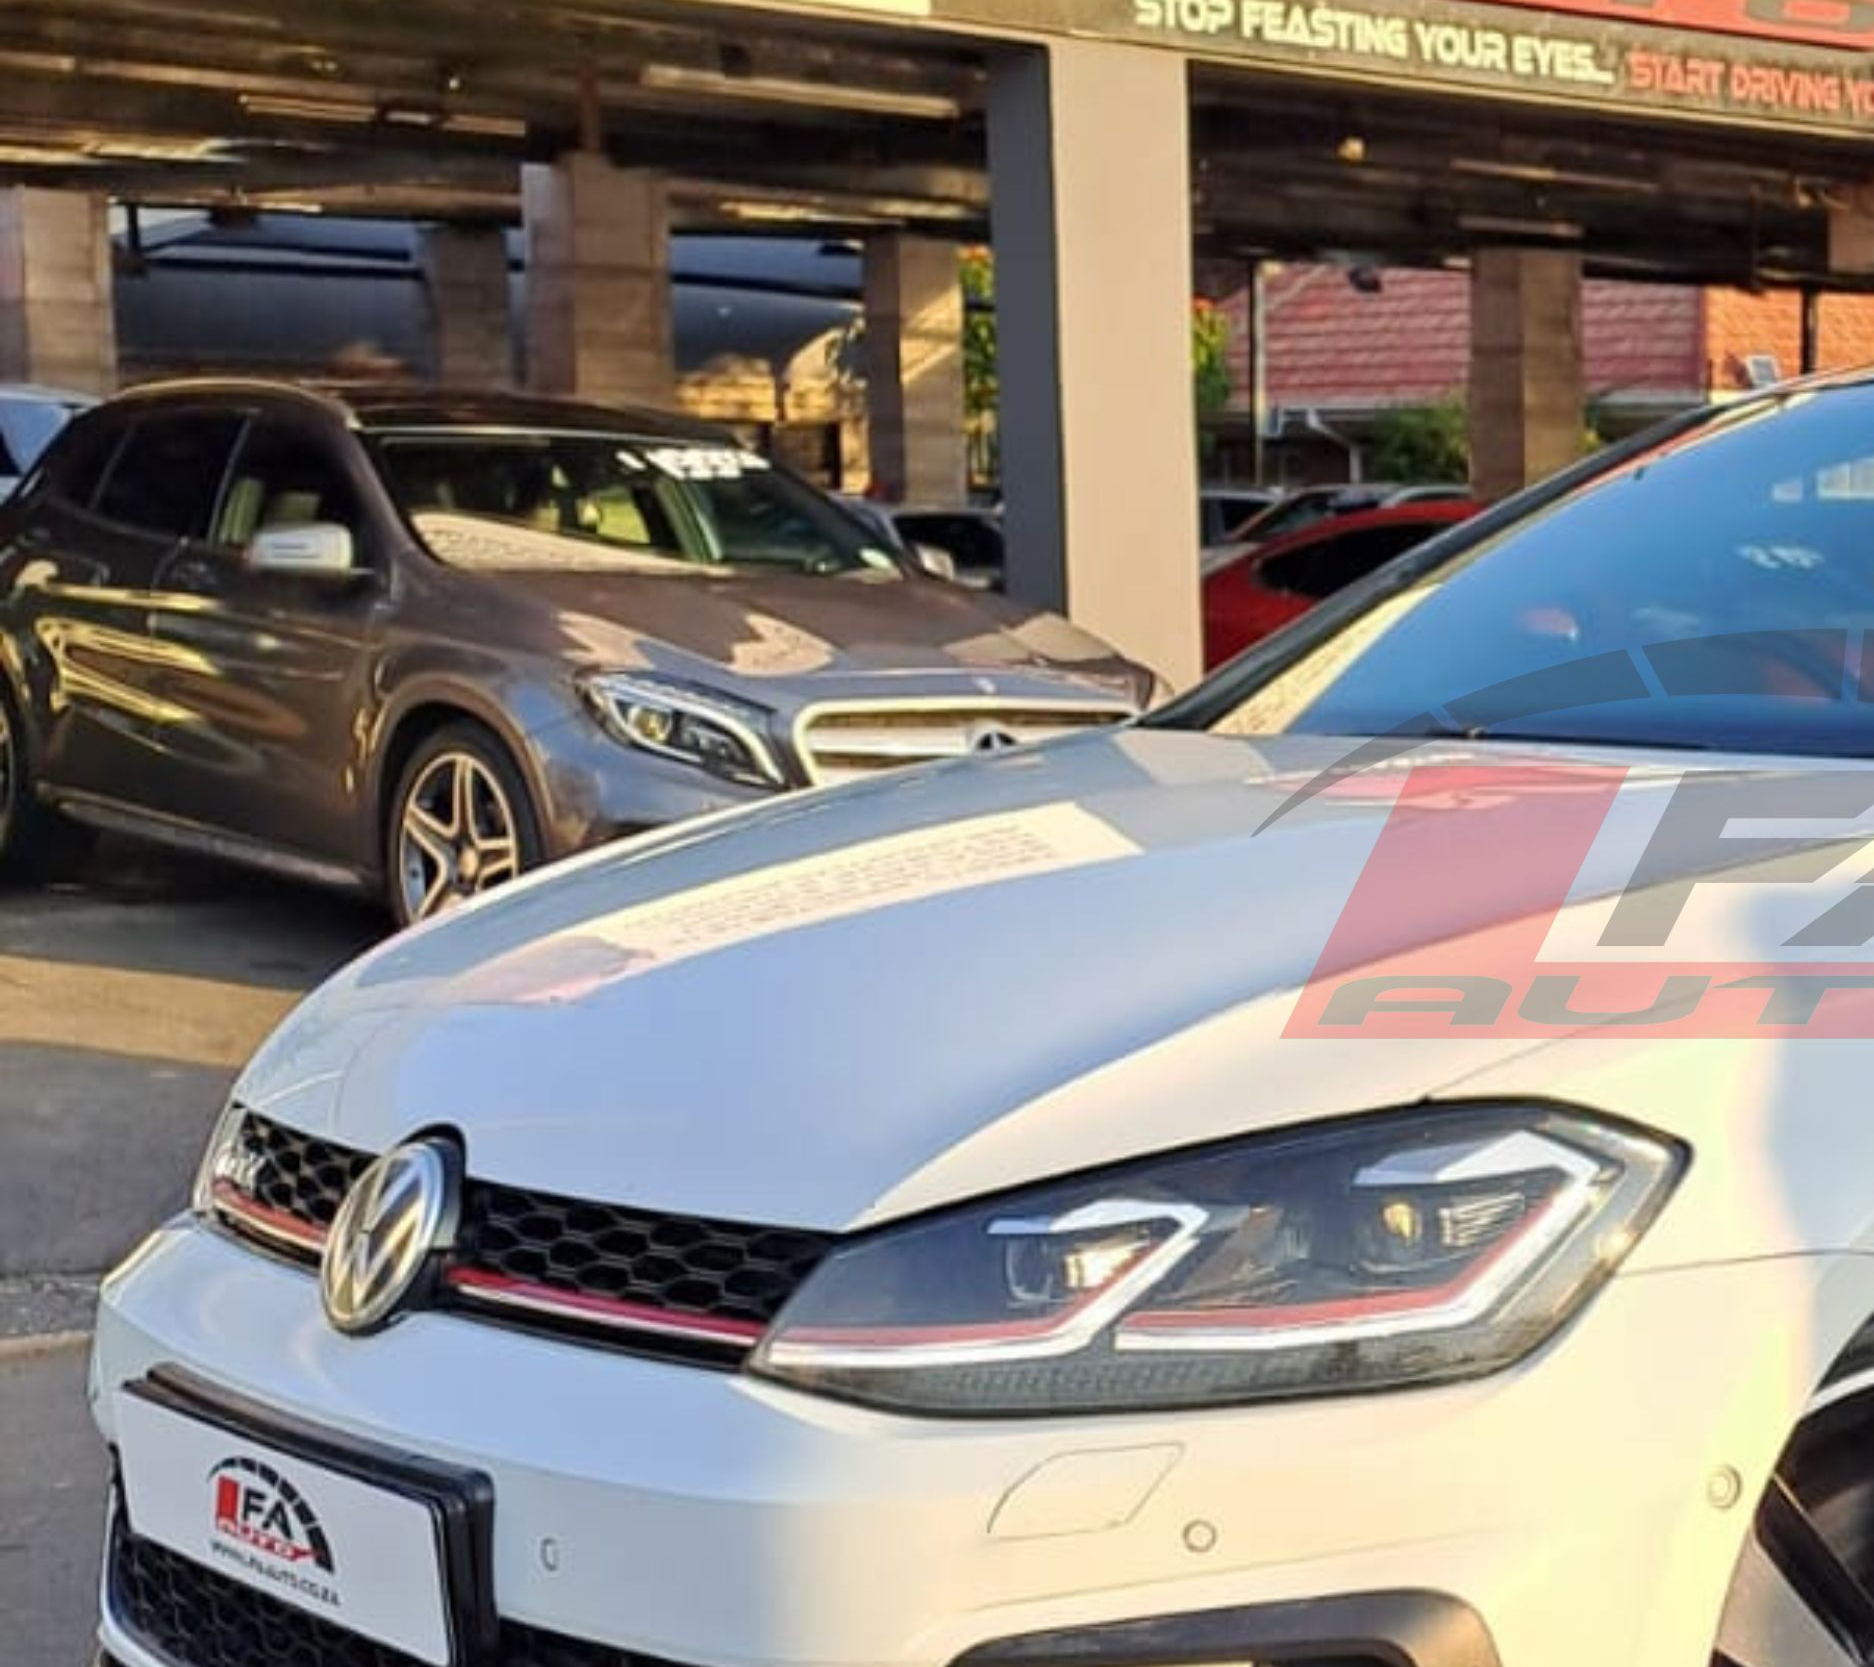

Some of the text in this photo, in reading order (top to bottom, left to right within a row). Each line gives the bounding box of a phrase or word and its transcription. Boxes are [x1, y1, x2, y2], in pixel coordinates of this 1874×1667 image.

[1413, 20, 1507, 68] YOUR
[1630, 49, 1725, 93] START
[1729, 65, 1842, 114] DRIVING
